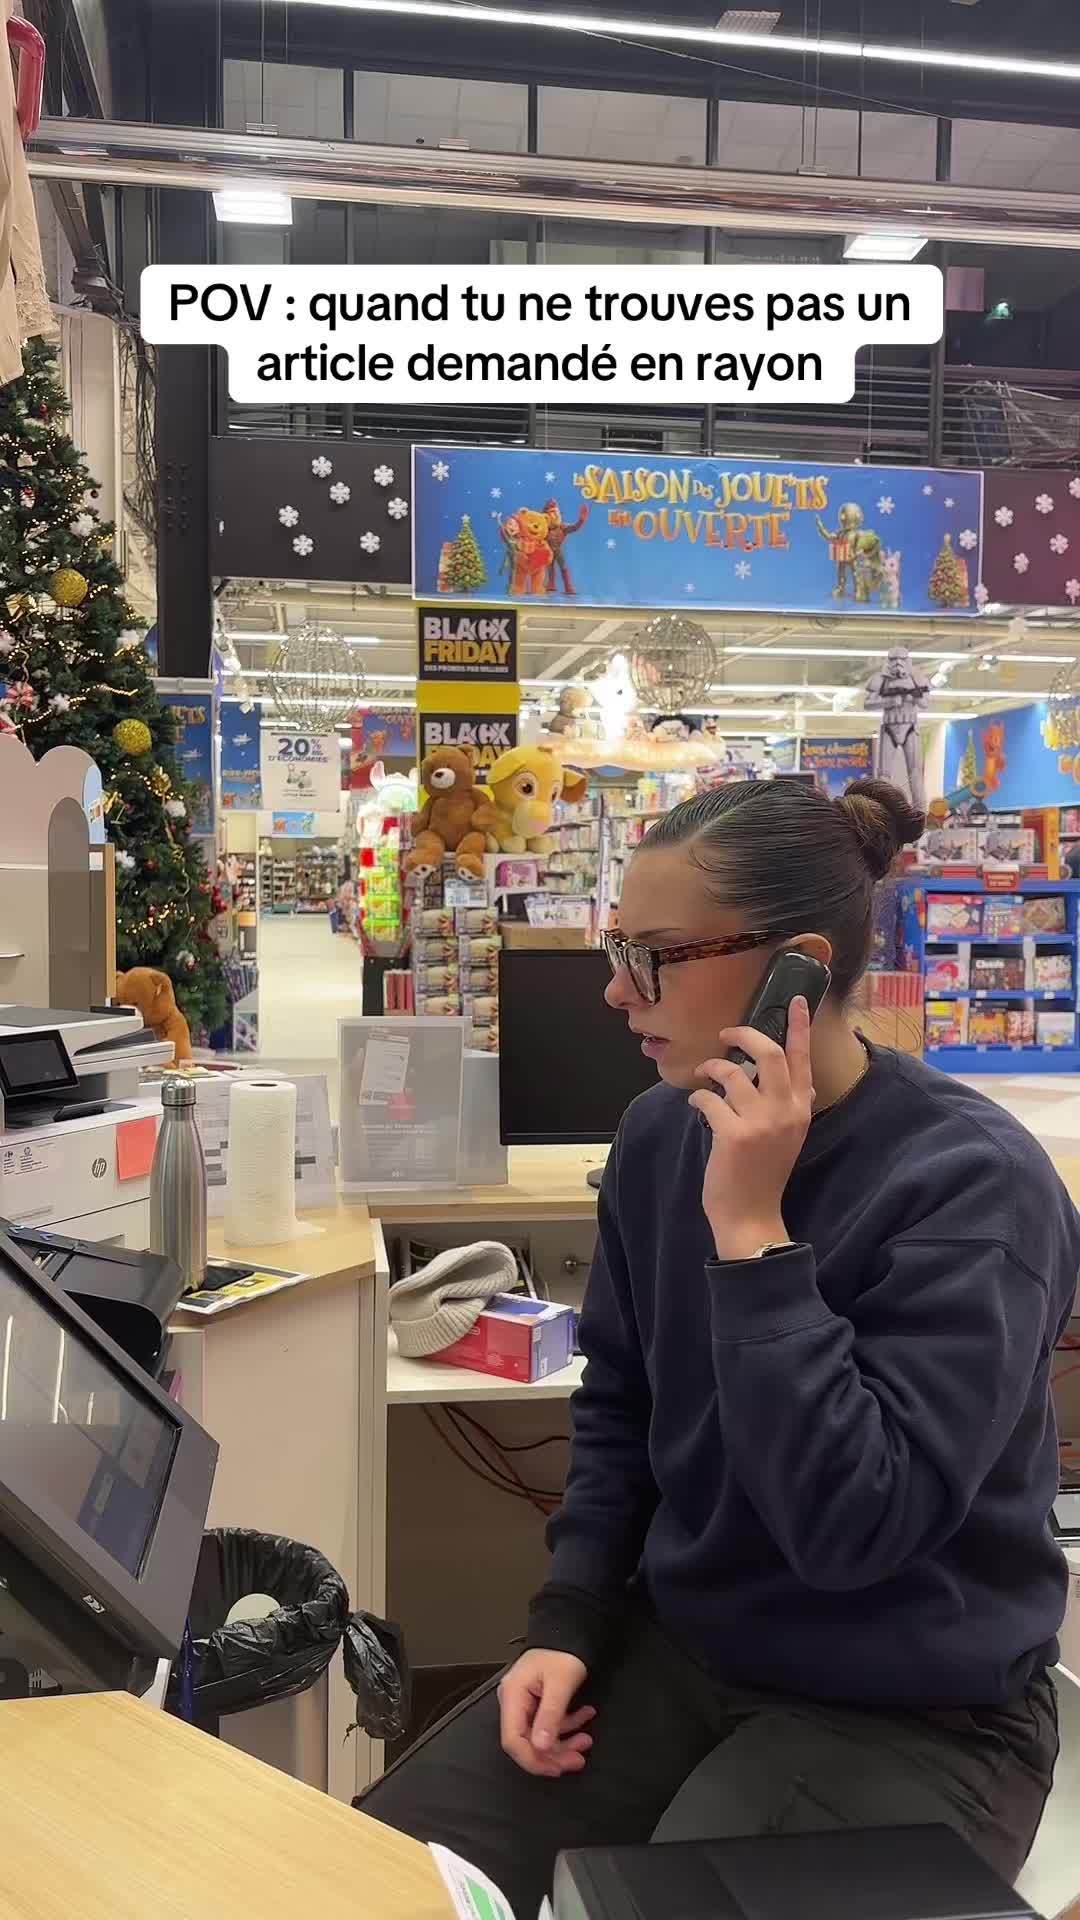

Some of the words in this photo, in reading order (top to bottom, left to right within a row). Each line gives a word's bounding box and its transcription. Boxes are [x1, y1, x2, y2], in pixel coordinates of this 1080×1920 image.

[581, 464, 692, 504] SAISON
[714, 471, 829, 511] JOUETS
[632, 507, 791, 552] OUVERTE
[423, 616, 511, 641] BLACK
[423, 640, 512, 665] FRIDAY
[424, 722, 511, 745] BLACK
